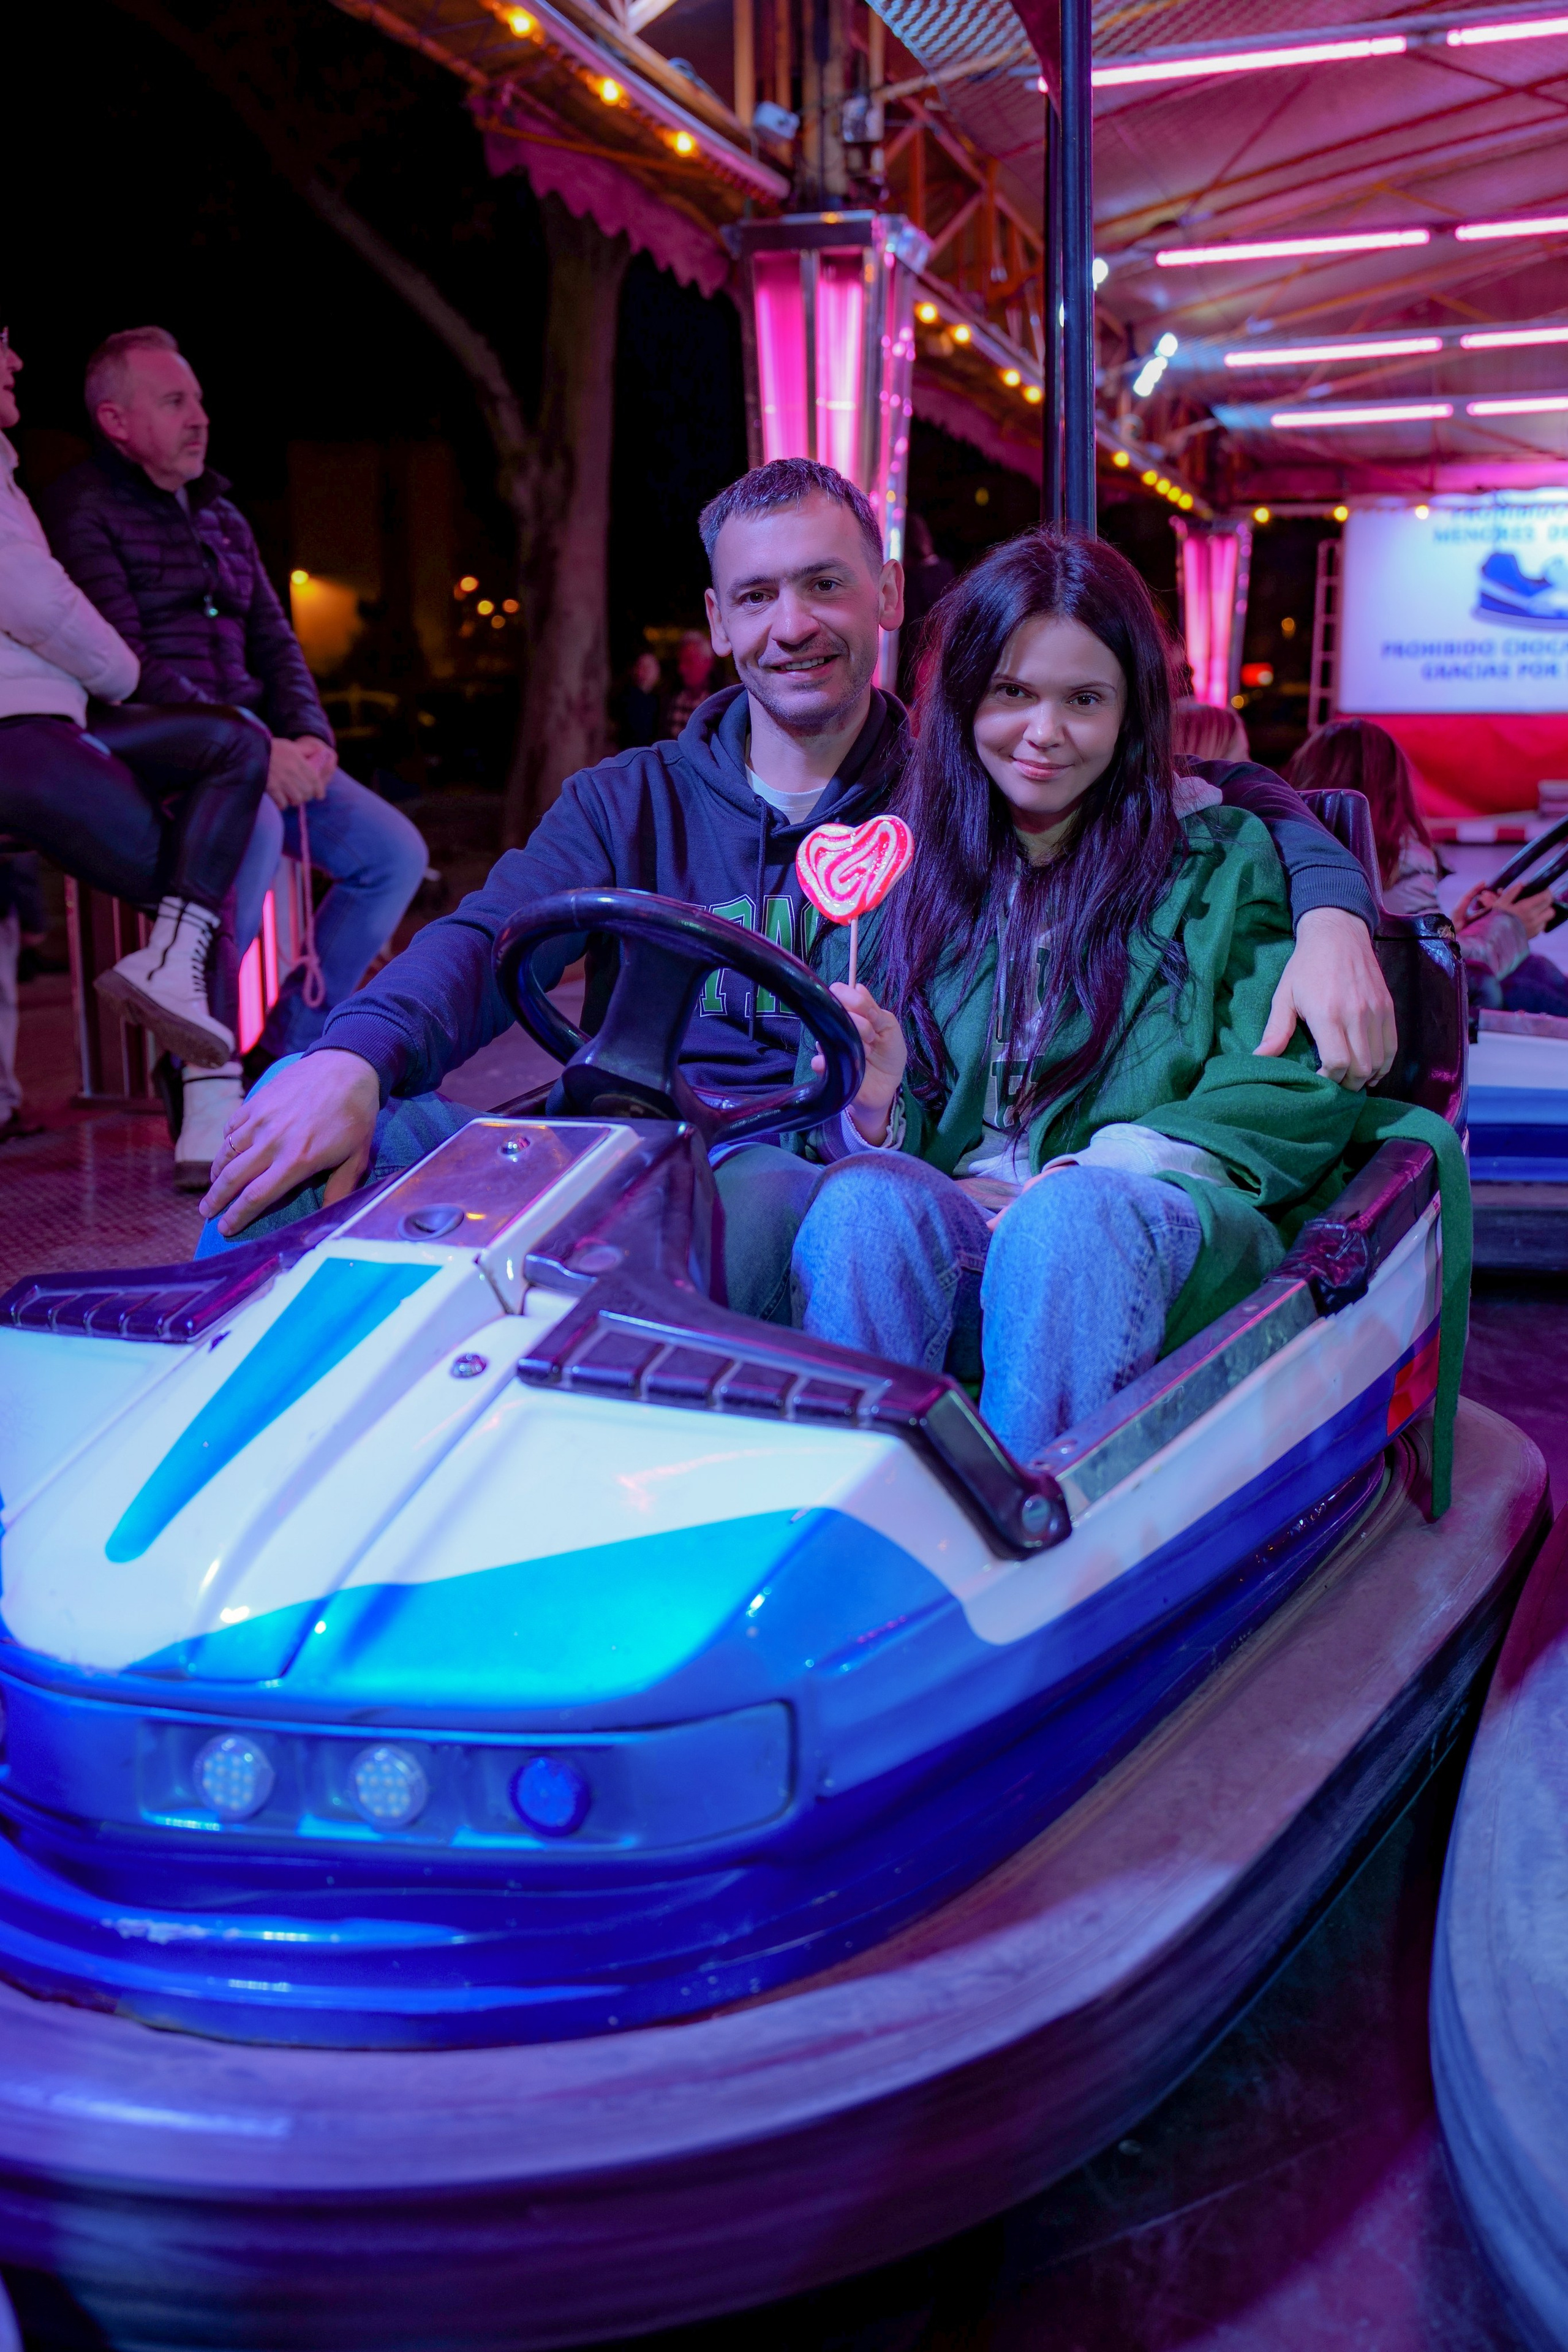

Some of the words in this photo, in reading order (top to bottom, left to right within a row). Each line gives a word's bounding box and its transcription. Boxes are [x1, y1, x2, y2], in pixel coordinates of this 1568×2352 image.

[1382, 639, 1494, 658] PROHIBIDO
[1422, 662, 1510, 680] GRACIAS
[1517, 662, 1559, 678] POR
